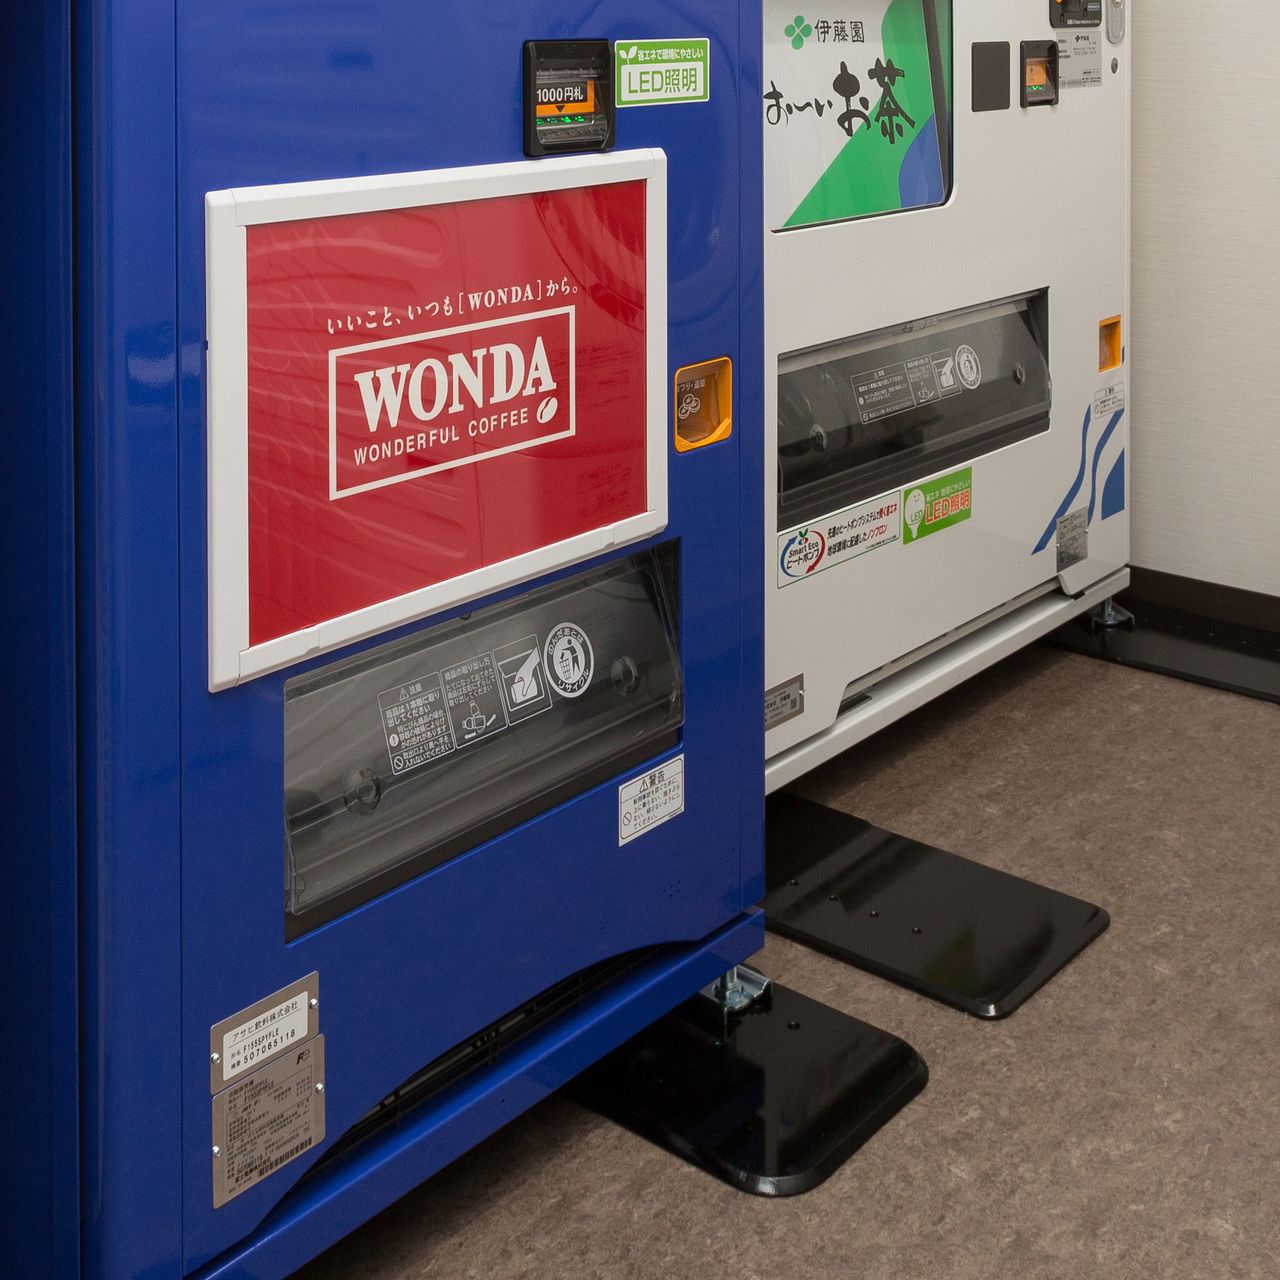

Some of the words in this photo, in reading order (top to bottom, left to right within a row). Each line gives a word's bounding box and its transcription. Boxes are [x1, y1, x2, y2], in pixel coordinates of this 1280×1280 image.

[814, 19, 866, 44] 伊藤園
[637, 47, 704, 62] 省エネで環境にやさしい
[626, 67, 698, 95] LED照明
[536, 86, 584, 103] 1000円札
[354, 335, 558, 433] WONDA
[354, 423, 460, 467] WONDERFUL
[468, 406, 529, 438] COFFEE
[910, 510, 924, 523] LED
[925, 488, 971, 525] LED照明
[786, 548, 820, 570] ヒートポンプ
[788, 544, 808, 559] Smart
[808, 541, 820, 552] Eco
[547, 626, 585, 656] のんだあとは
[557, 668, 590, 693] リサイクル
[231, 1000, 299, 1042] アサヒ飲料株式会社
[243, 1031, 296, 1065] 507065118
